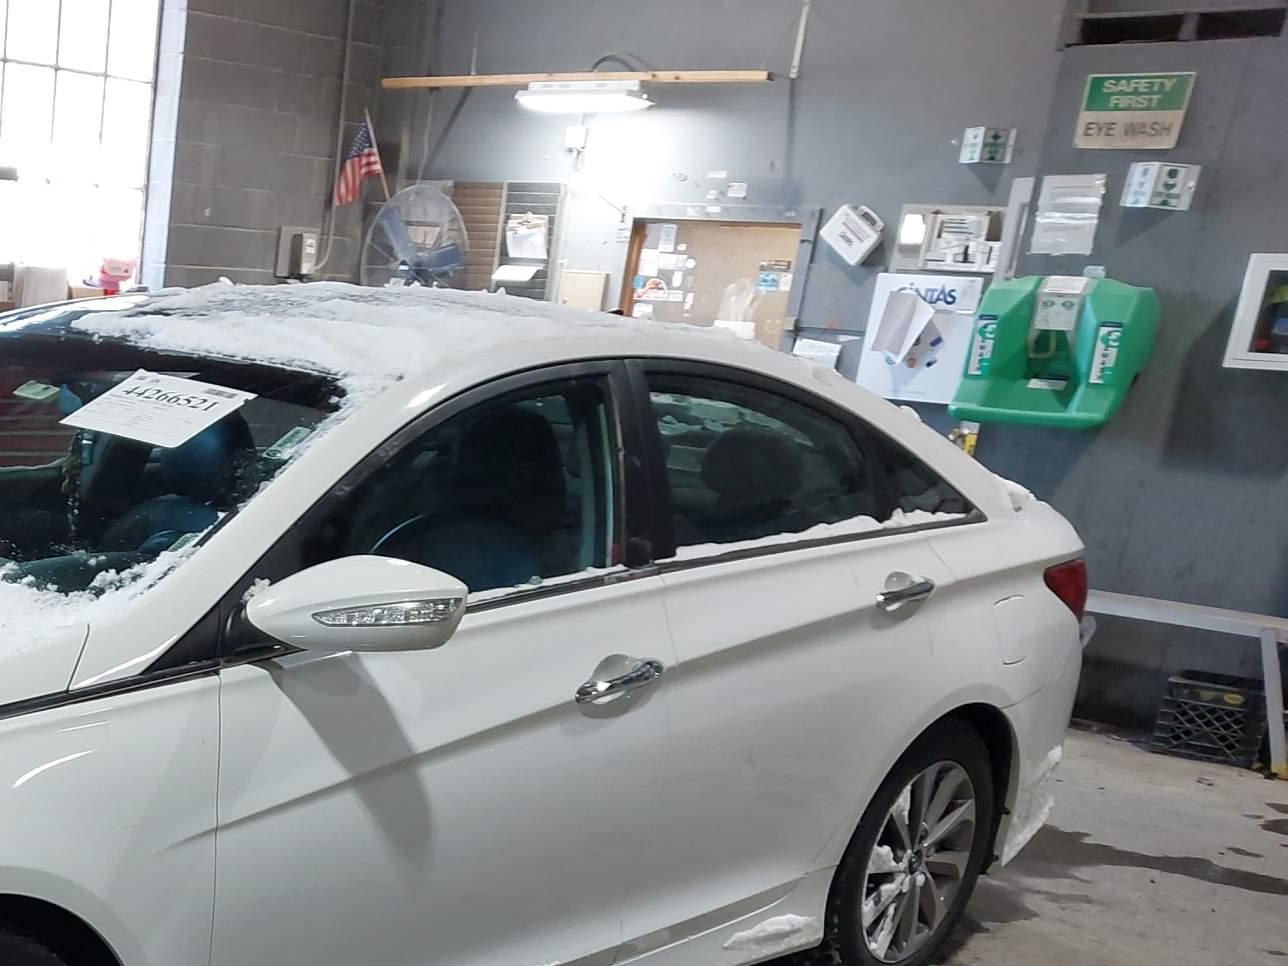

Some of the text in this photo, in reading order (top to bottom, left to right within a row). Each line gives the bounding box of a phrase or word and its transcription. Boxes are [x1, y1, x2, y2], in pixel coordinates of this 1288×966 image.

[1102, 78, 1177, 93] SAFETY
[1108, 94, 1163, 108] FIRST
[1083, 121, 1173, 138] EYE WASH
[896, 282, 957, 305] NTAS
[122, 385, 220, 412] 44266521
